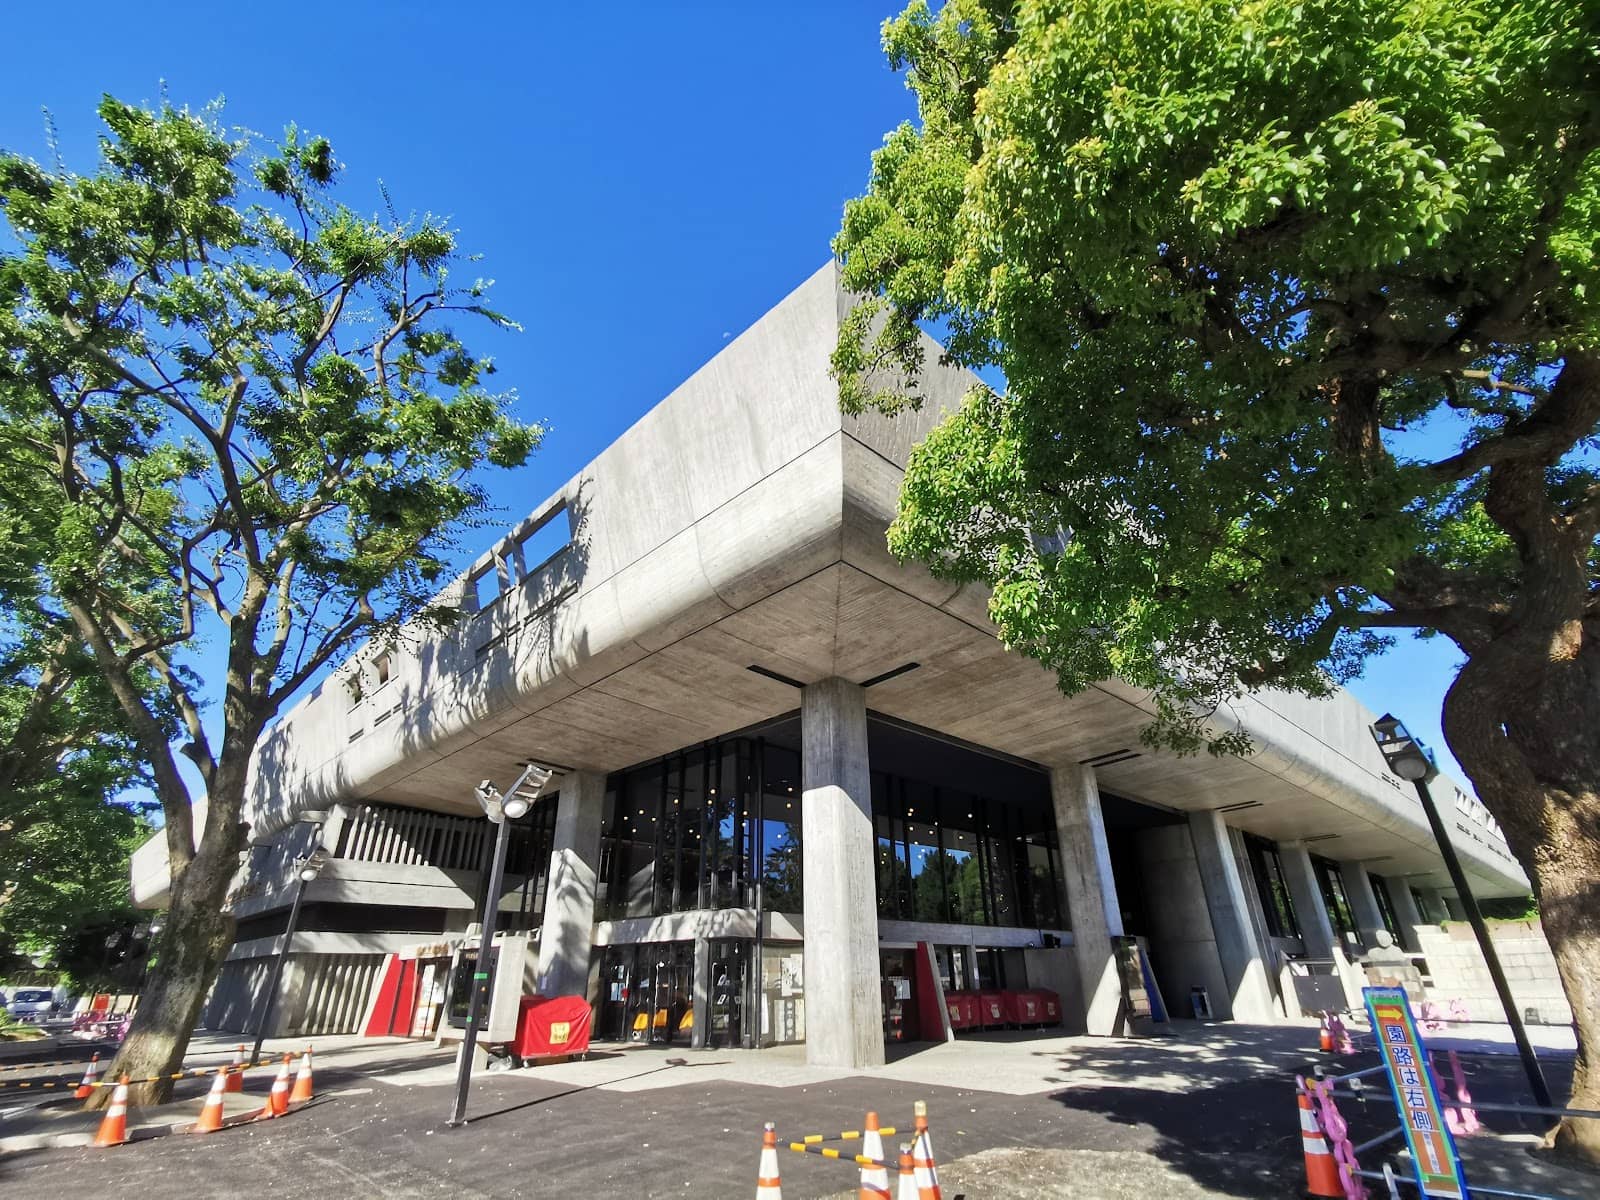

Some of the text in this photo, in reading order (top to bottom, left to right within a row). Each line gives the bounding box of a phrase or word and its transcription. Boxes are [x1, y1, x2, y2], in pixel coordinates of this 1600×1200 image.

[1386, 1025, 1433, 1130] 園路は右側
